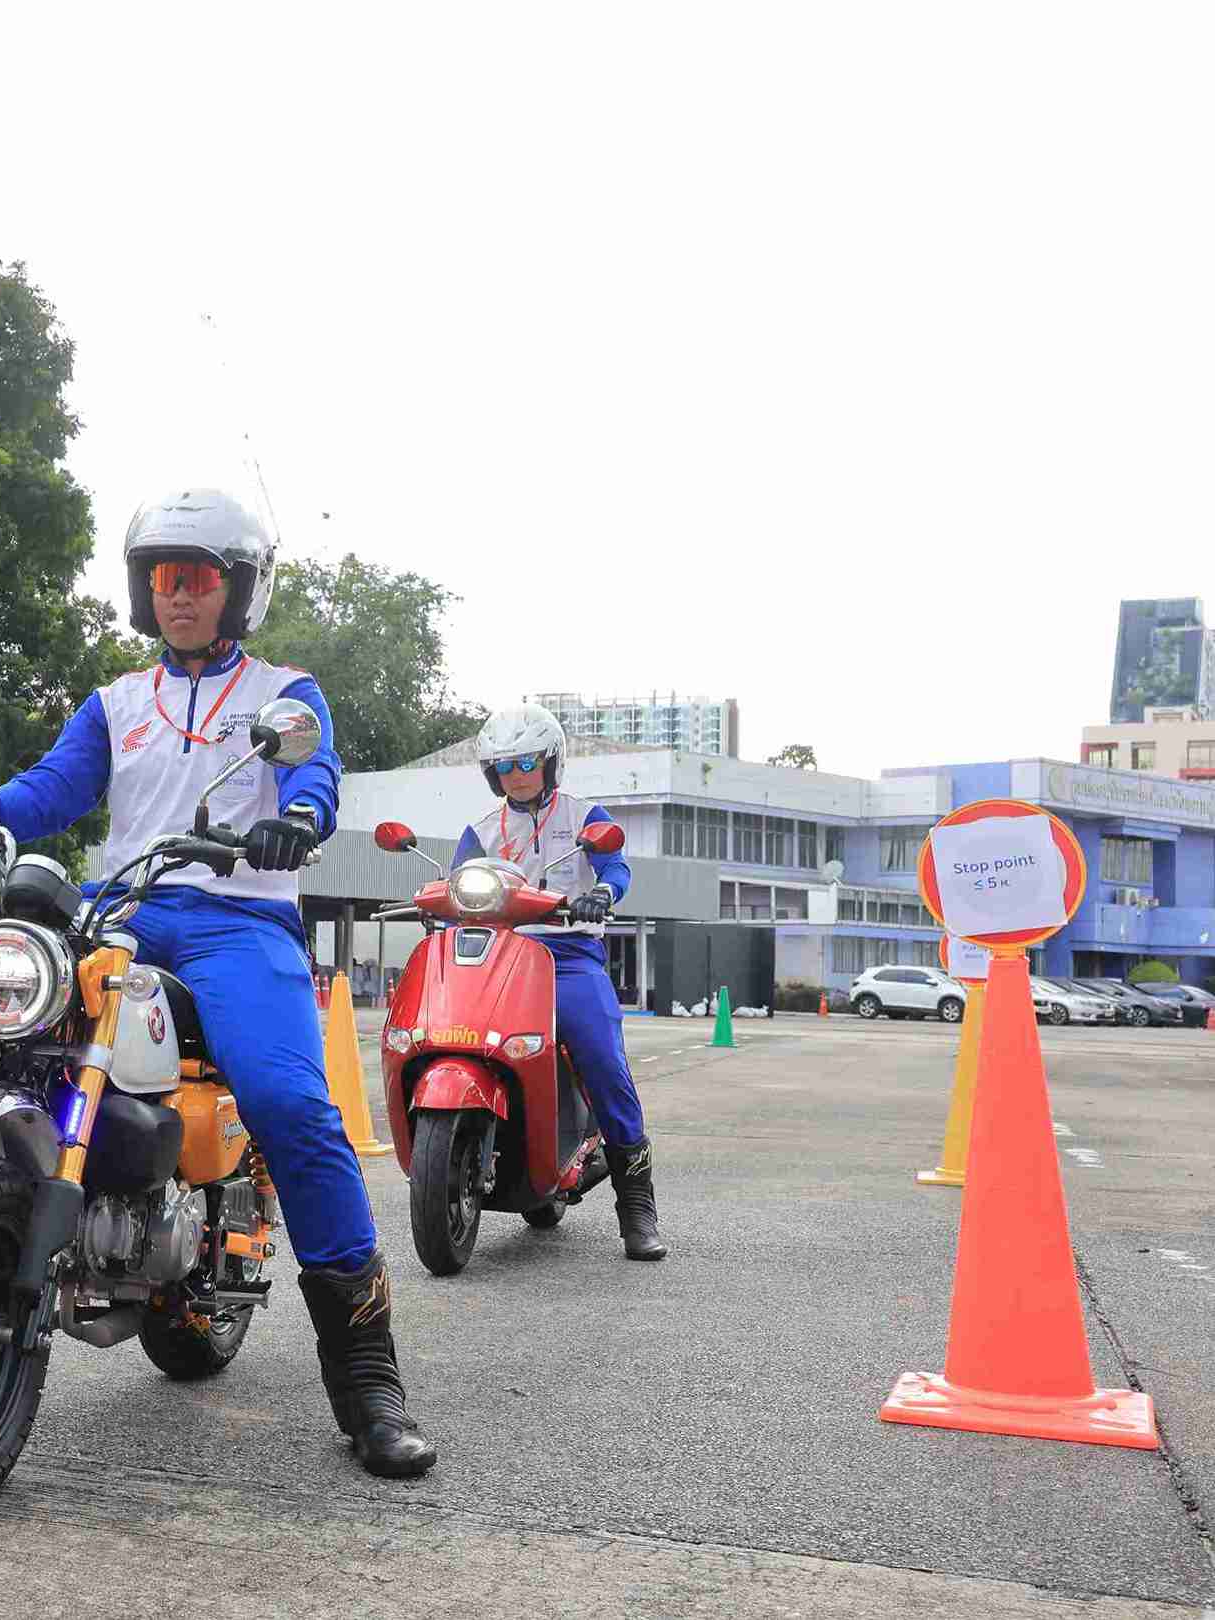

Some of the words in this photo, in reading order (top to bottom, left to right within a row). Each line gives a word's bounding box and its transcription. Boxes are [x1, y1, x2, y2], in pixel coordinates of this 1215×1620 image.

[953, 862, 989, 874] Stop
[994, 855, 1036, 872] point
[987, 876, 997, 889] 5
